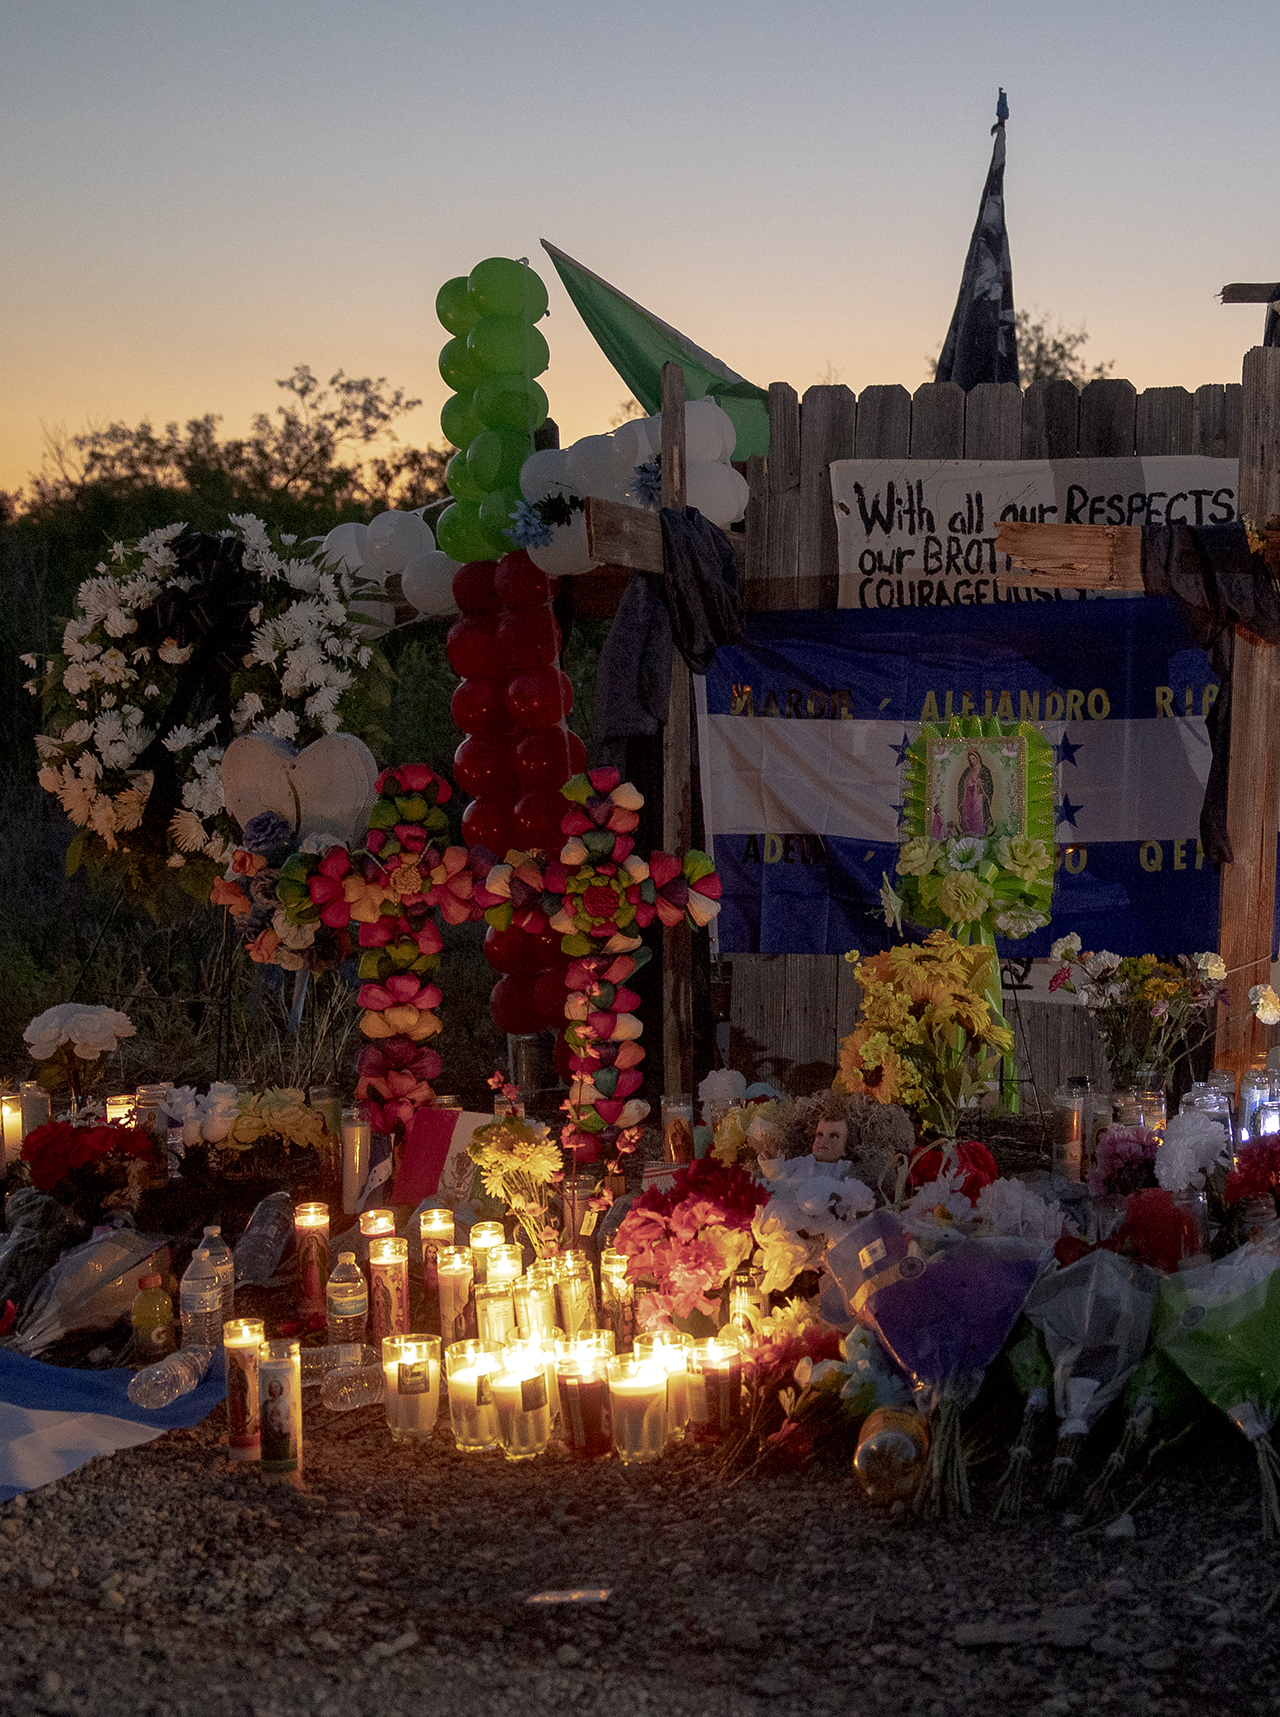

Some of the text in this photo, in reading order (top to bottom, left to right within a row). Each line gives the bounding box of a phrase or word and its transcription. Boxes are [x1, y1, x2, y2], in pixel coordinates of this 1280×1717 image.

[853, 480, 937, 534] With
[948, 490, 985, 534] all
[859, 547, 914, 577] our
[921, 690, 1111, 722] ALEJANDRO
